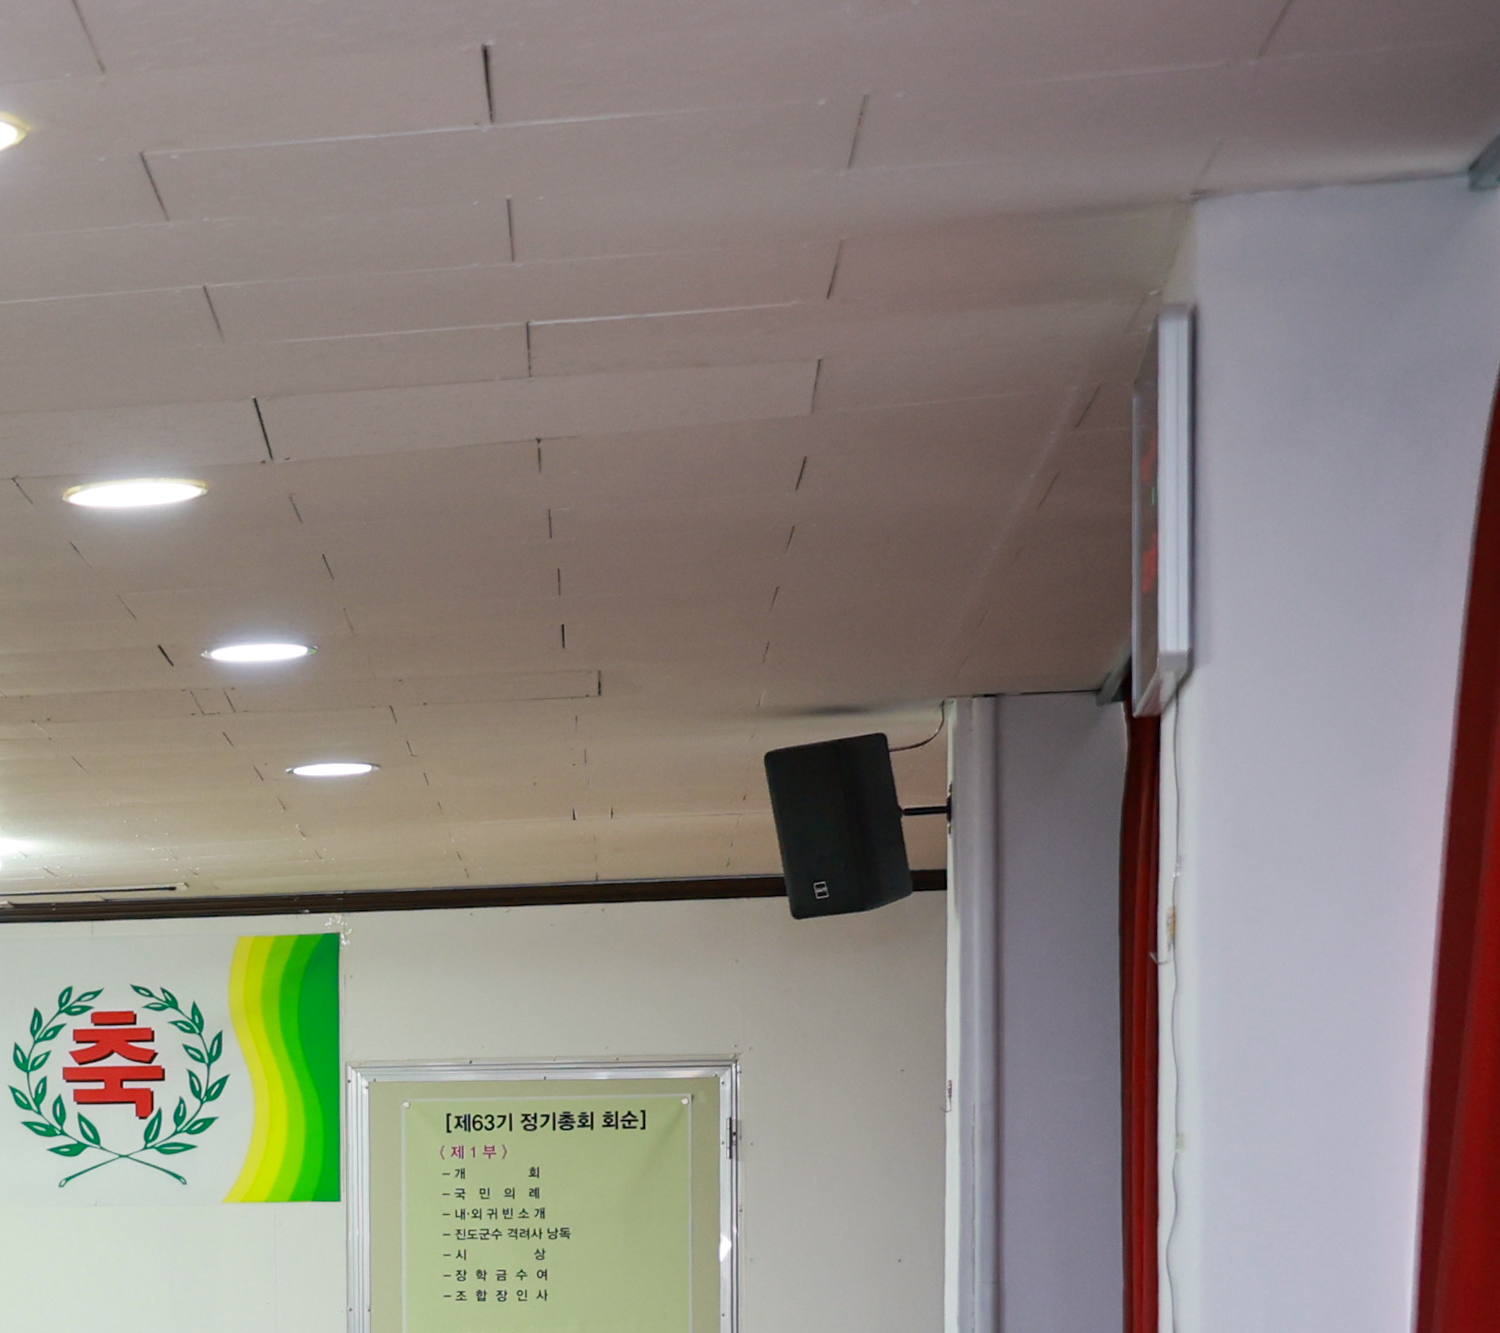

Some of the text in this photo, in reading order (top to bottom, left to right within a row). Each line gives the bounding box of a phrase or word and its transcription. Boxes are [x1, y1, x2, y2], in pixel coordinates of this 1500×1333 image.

[62, 1010, 166, 1119] 축
[446, 1109, 646, 1133] [제63기 정기총회 회순]
[454, 1227, 572, 1241] 진도군수 격려사 낭독
